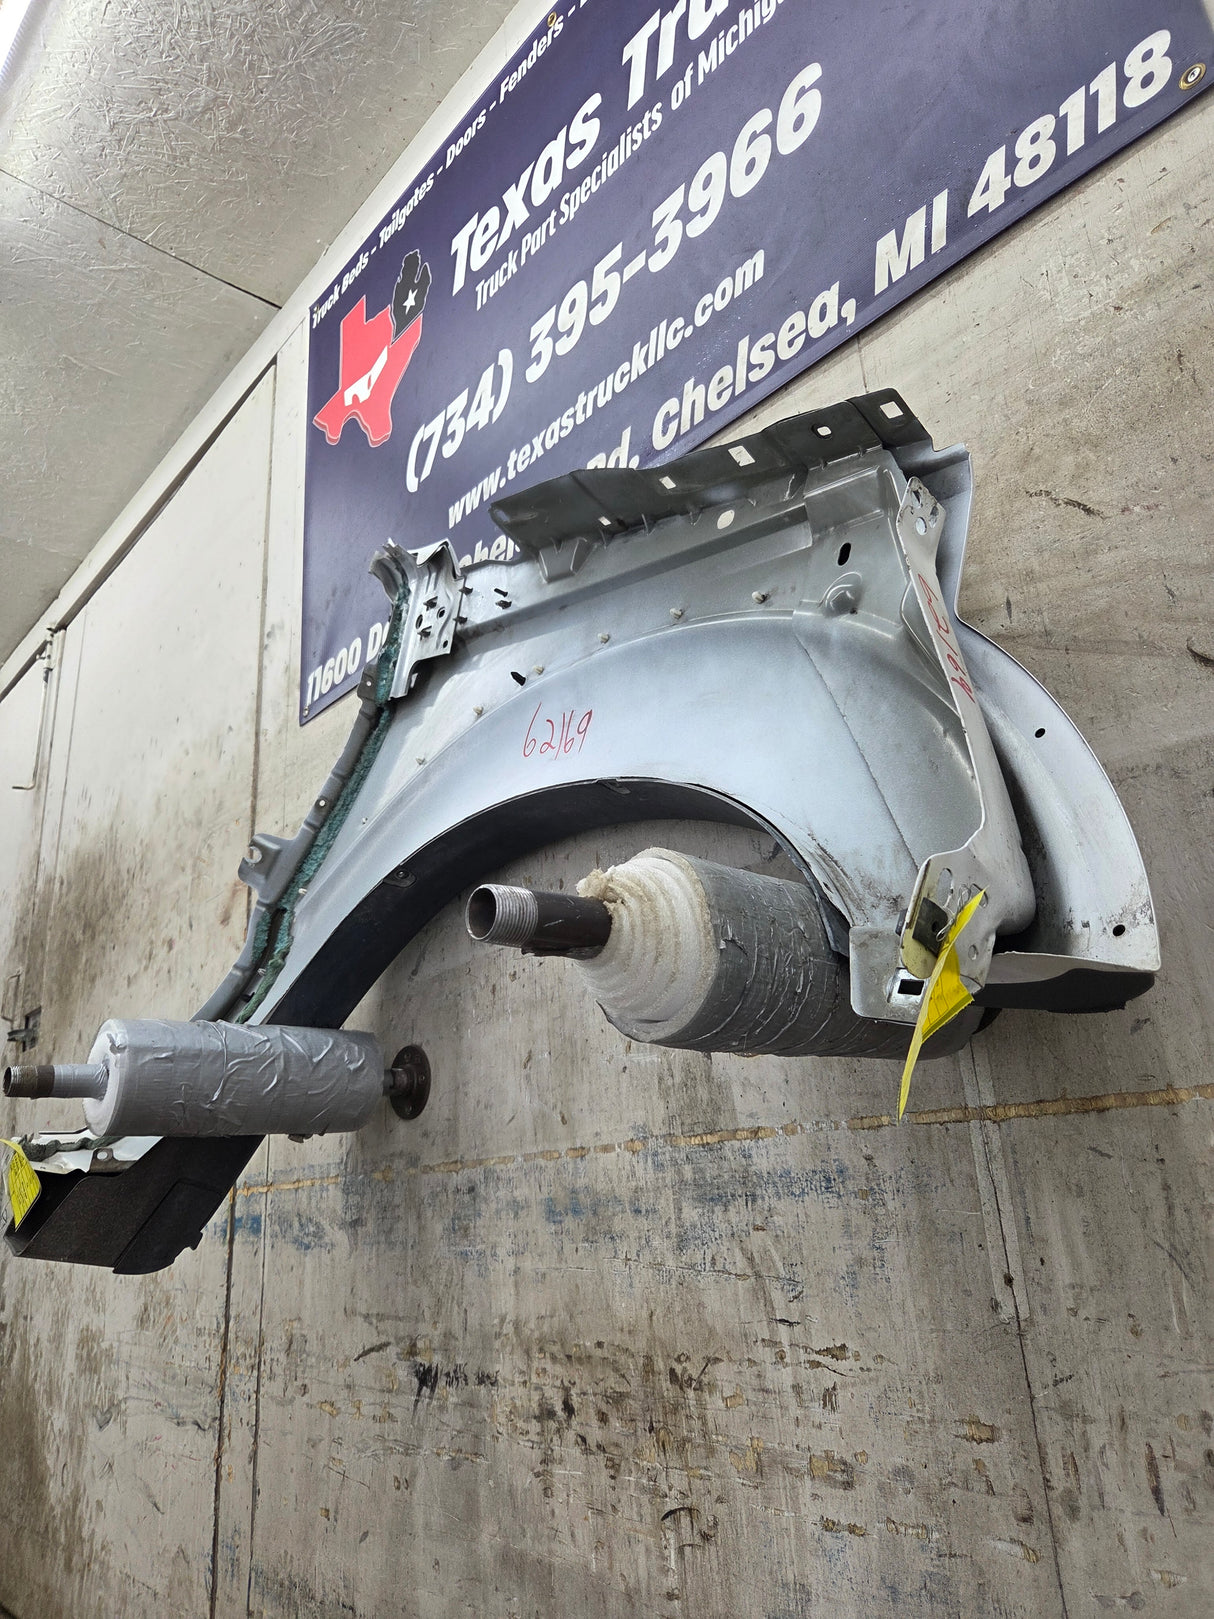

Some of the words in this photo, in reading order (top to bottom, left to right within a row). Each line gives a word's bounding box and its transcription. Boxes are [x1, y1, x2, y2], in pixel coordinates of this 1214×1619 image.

[313, 284, 341, 328] Truck
[341, 251, 369, 294] Beds
[379, 173, 434, 248] Tailgates
[446, 109, 486, 169] Doors
[500, 15, 564, 104] Fenders
[406, 348, 514, 493] (734)
[525, 62, 822, 383] 395-3966
[451, 92, 602, 296] Texas
[475, 249, 519, 311] Truck
[521, 209, 557, 266] Part
[559, 102, 663, 225] Specialists
[671, 62, 694, 110] of
[698, 0, 784, 86] Michig
[306, 637, 361, 706] 11600
[652, 280, 857, 451] Chelsea,
[874, 188, 948, 297] MI
[967, 29, 1173, 218] 48118
[448, 249, 765, 529] www.texastruckllc.com
[523, 701, 593, 760] 62169
